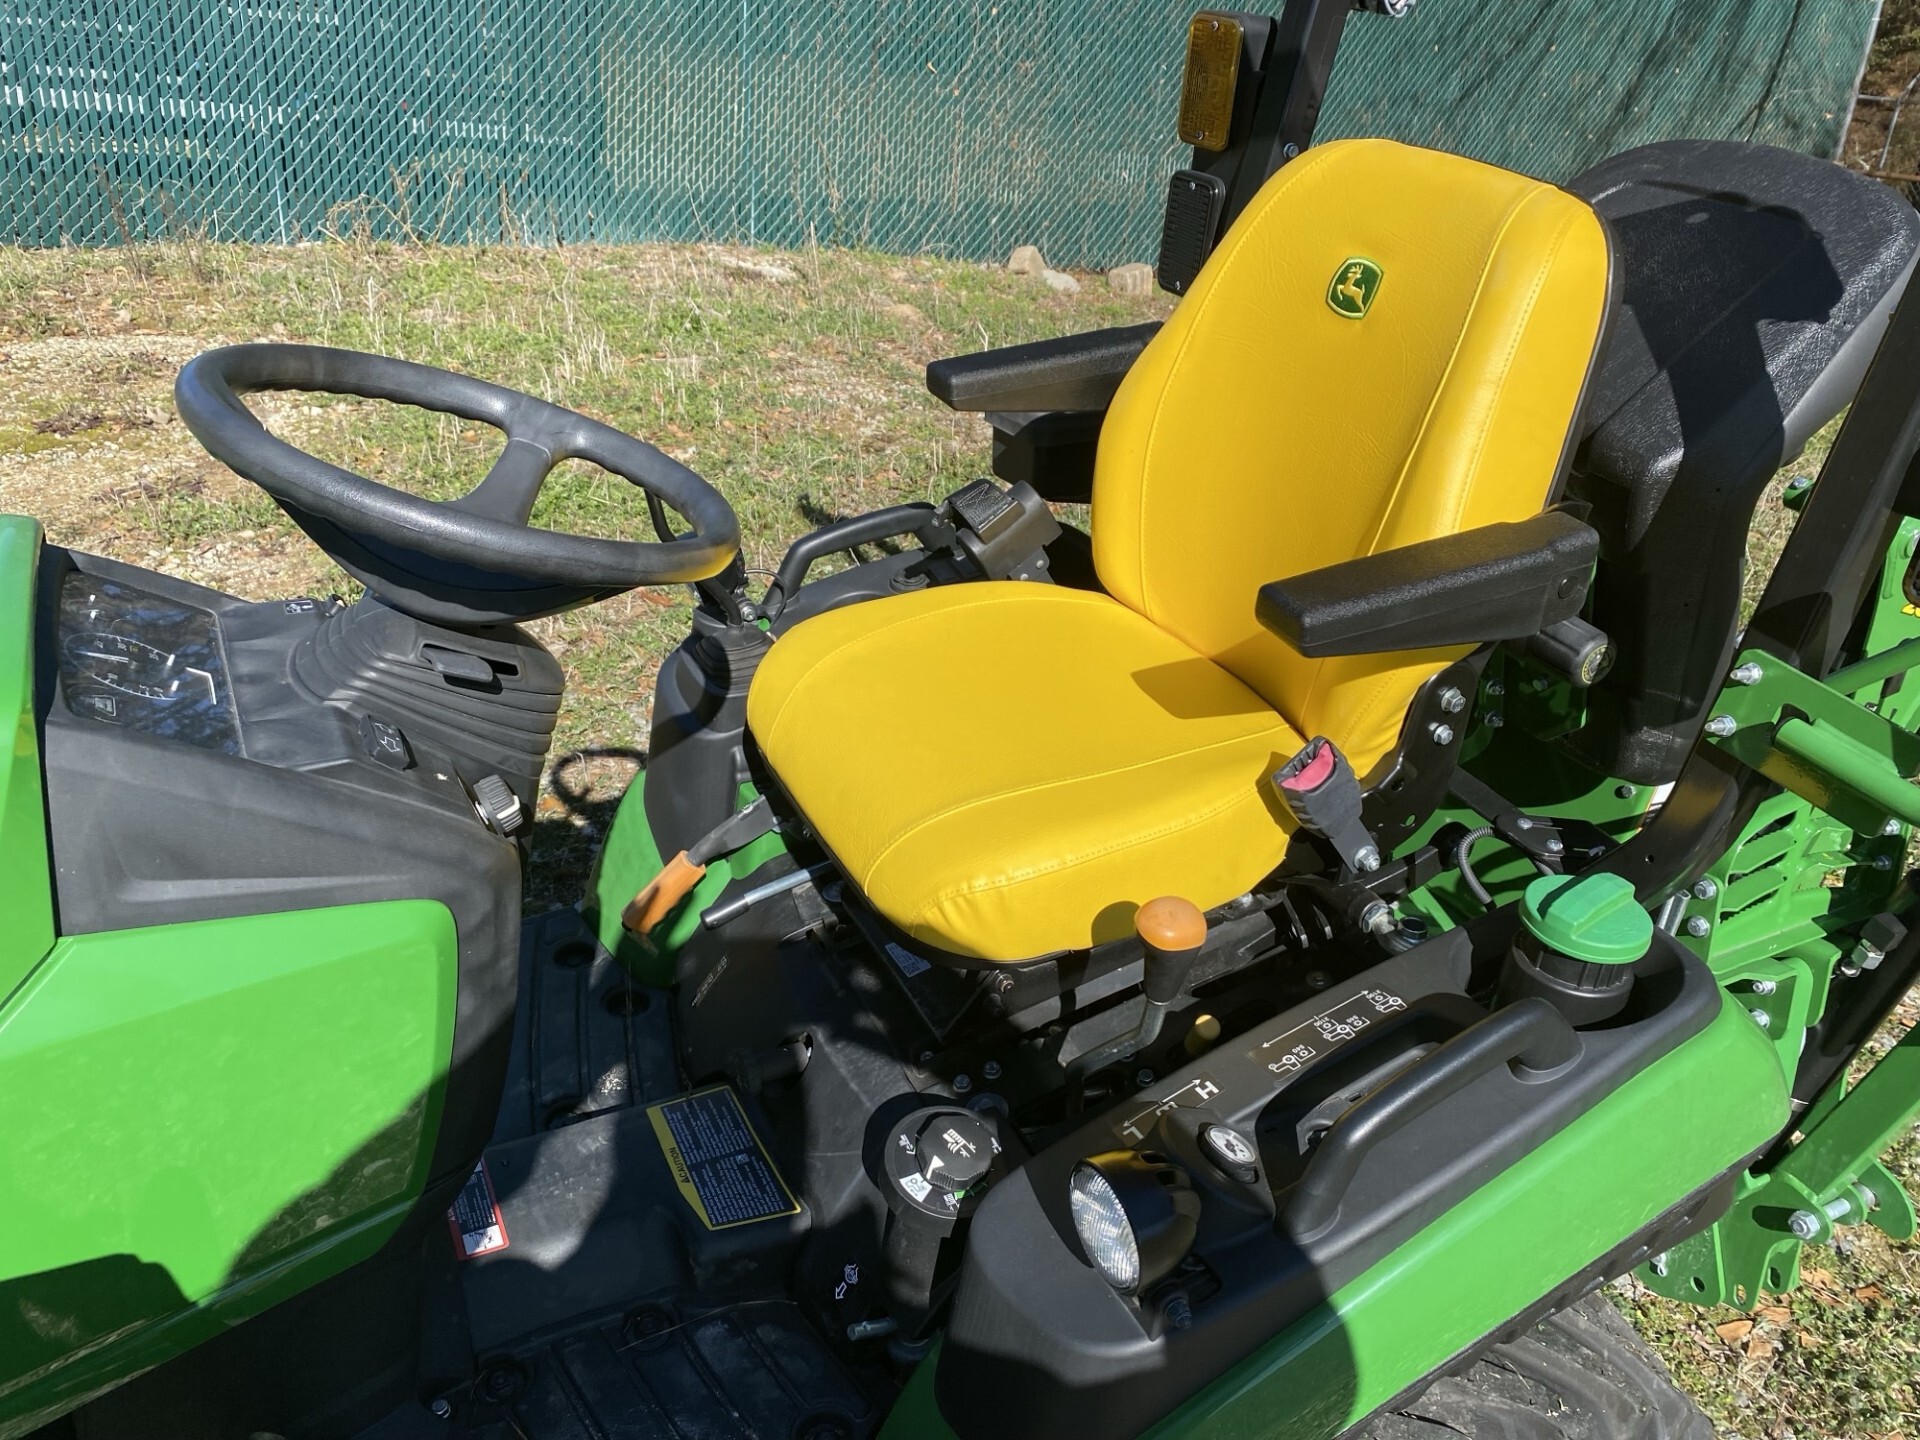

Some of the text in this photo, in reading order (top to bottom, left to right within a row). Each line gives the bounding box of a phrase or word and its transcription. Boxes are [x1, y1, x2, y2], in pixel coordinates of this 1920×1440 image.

[1195, 1081, 1219, 1100] H
[1122, 1126, 1144, 1140] L
[669, 1147, 687, 1178] CAUTION
